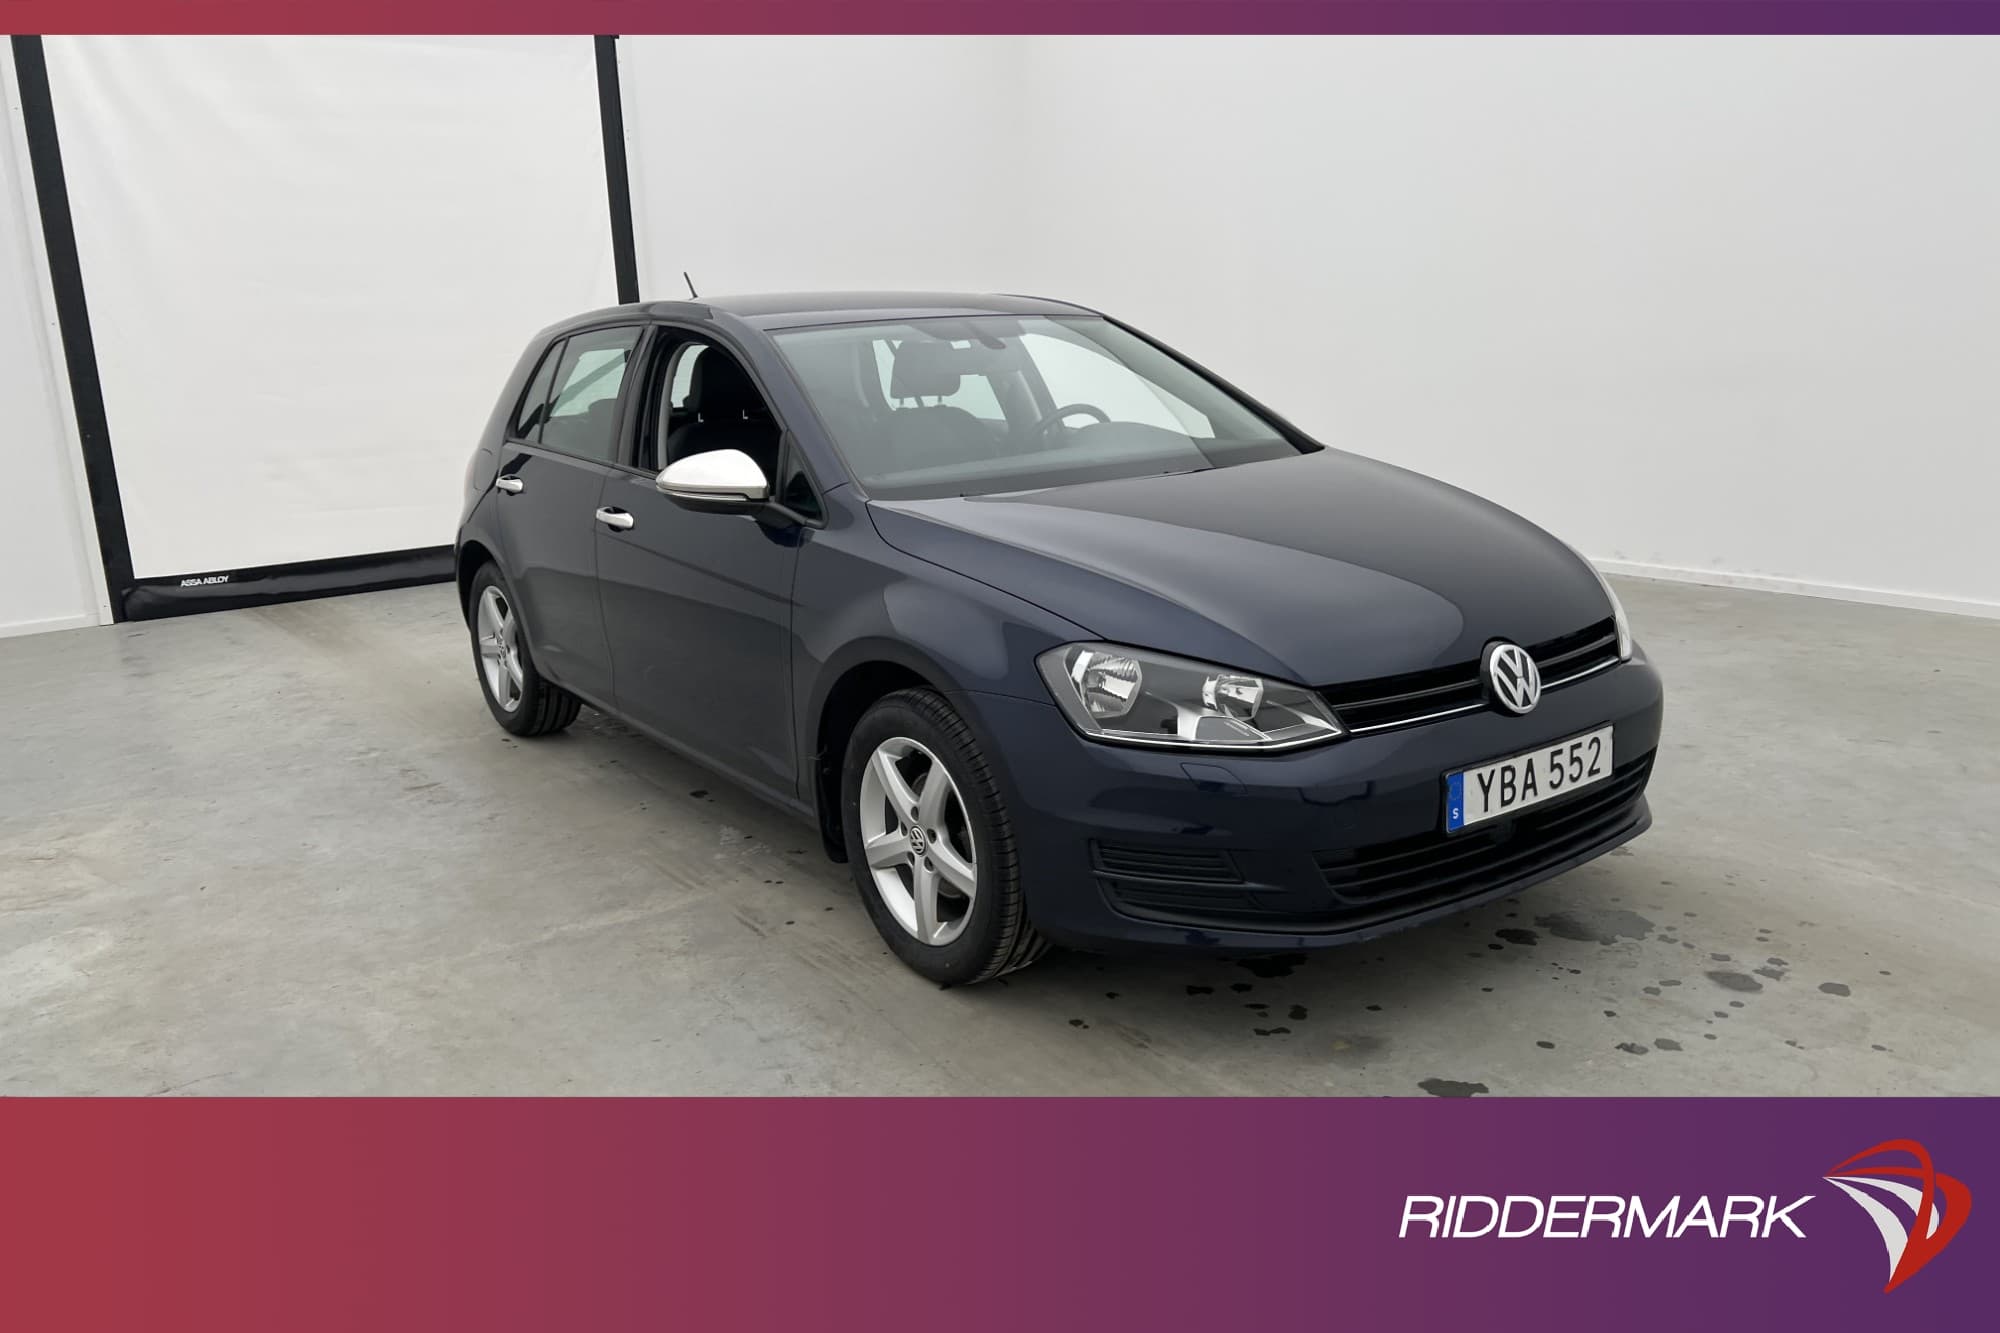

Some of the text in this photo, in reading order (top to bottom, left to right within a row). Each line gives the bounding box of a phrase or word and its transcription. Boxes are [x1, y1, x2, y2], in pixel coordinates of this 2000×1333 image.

[181, 576, 228, 587] ASSA ABLOY
[1477, 736, 1601, 813] YBA 552
[1452, 808, 1459, 819] S
